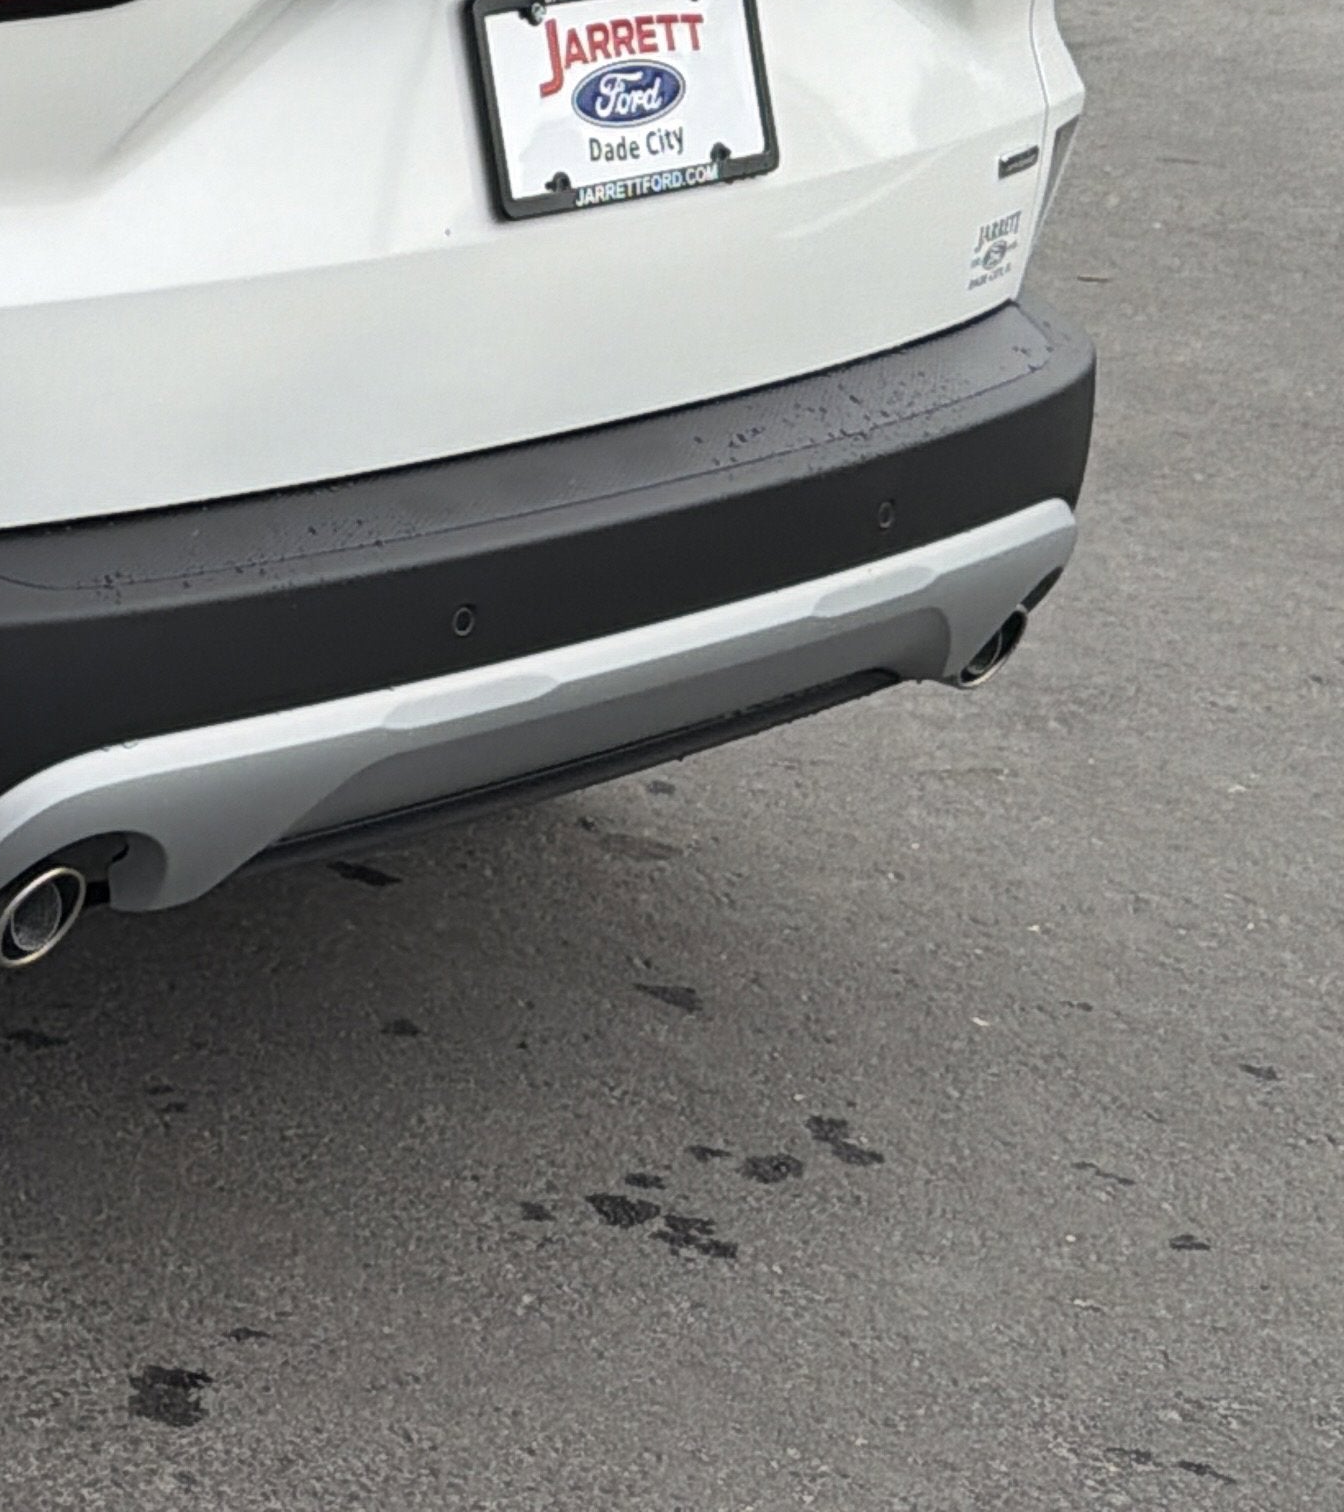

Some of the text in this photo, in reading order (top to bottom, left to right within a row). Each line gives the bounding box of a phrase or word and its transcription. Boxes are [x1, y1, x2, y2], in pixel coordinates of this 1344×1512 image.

[540, 13, 704, 98] JARRETT
[595, 71, 662, 117] Ford
[588, 125, 684, 162] Dade City
[575, 162, 719, 207] JARRETTFORD.COM
